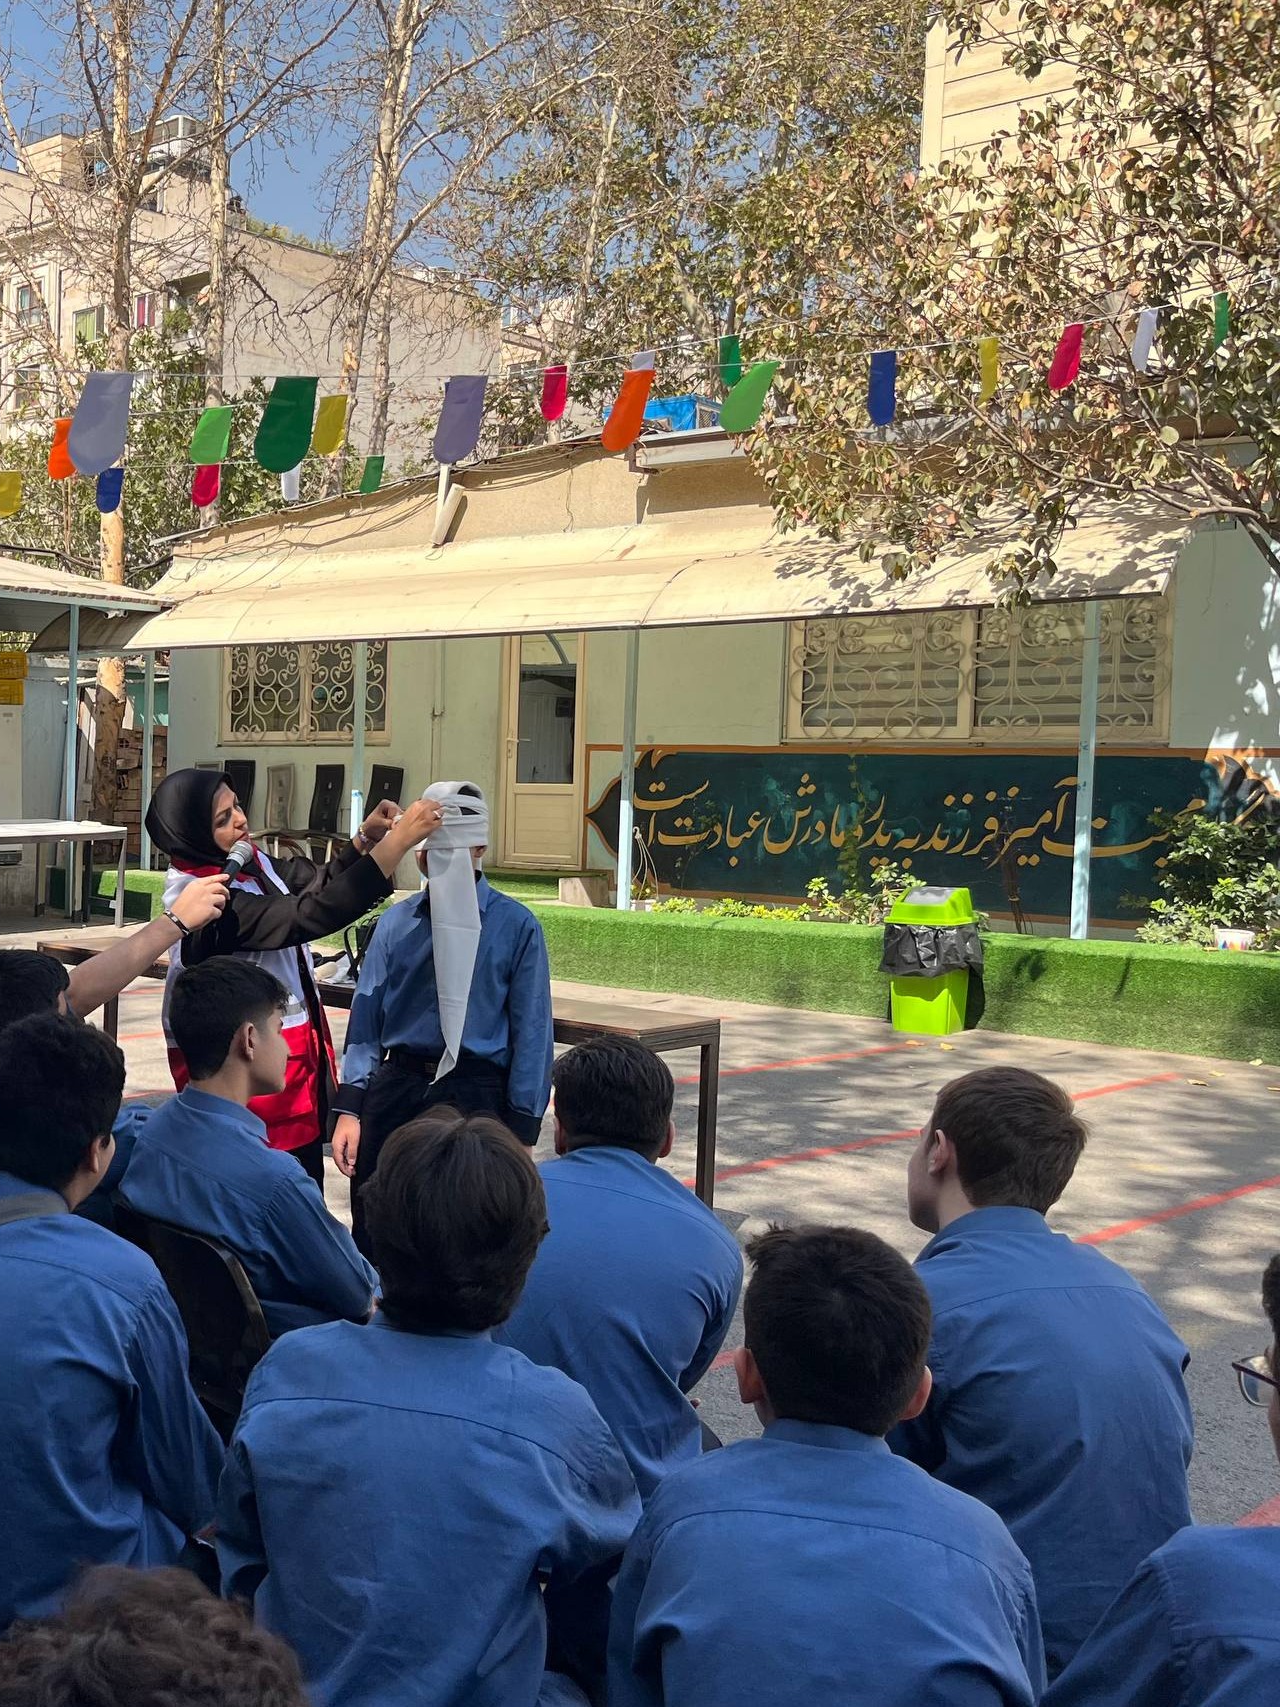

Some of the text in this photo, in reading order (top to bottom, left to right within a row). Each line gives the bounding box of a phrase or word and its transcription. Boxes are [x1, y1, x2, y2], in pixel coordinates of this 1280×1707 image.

[632, 779, 710, 849] است
[657, 804, 767, 868] عبادت
[912, 790, 998, 856] فرزند
[892, 833, 921, 870] به
